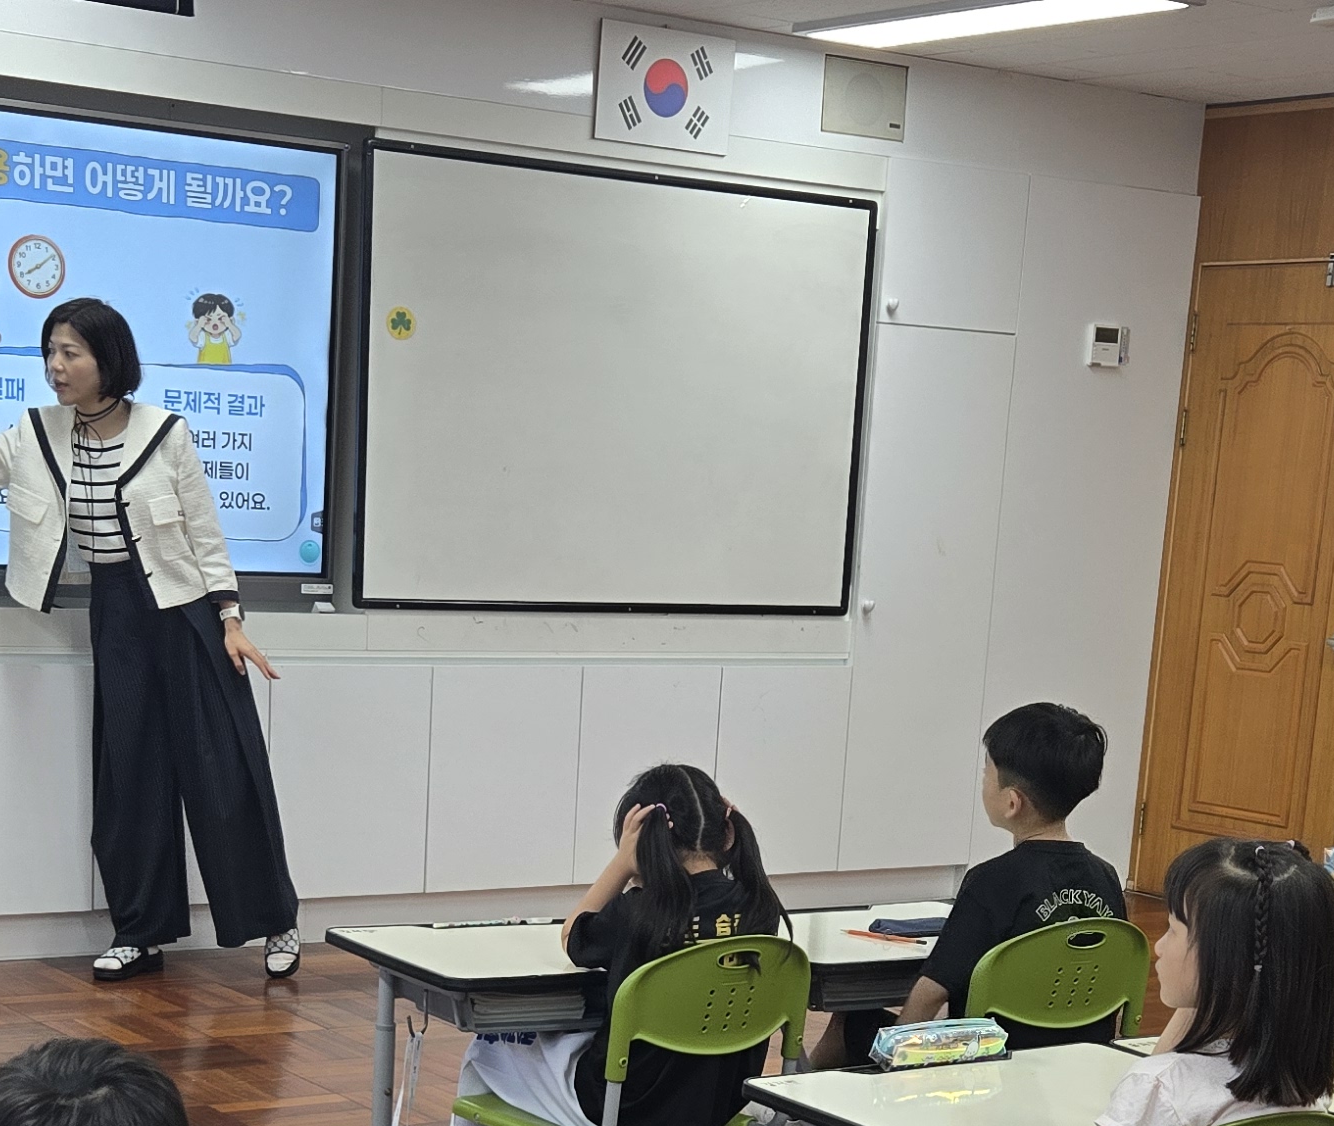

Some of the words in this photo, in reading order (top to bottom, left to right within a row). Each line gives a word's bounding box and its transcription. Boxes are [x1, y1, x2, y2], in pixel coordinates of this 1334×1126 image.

[84, 160, 176, 205] 어떻게
[185, 172, 293, 216] 될까요?
[163, 389, 221, 415] 문제적
[227, 394, 265, 417] 결과
[221, 431, 253, 451] 가지
[203, 461, 250, 481] 제들이
[219, 491, 271, 511] 있어요.
